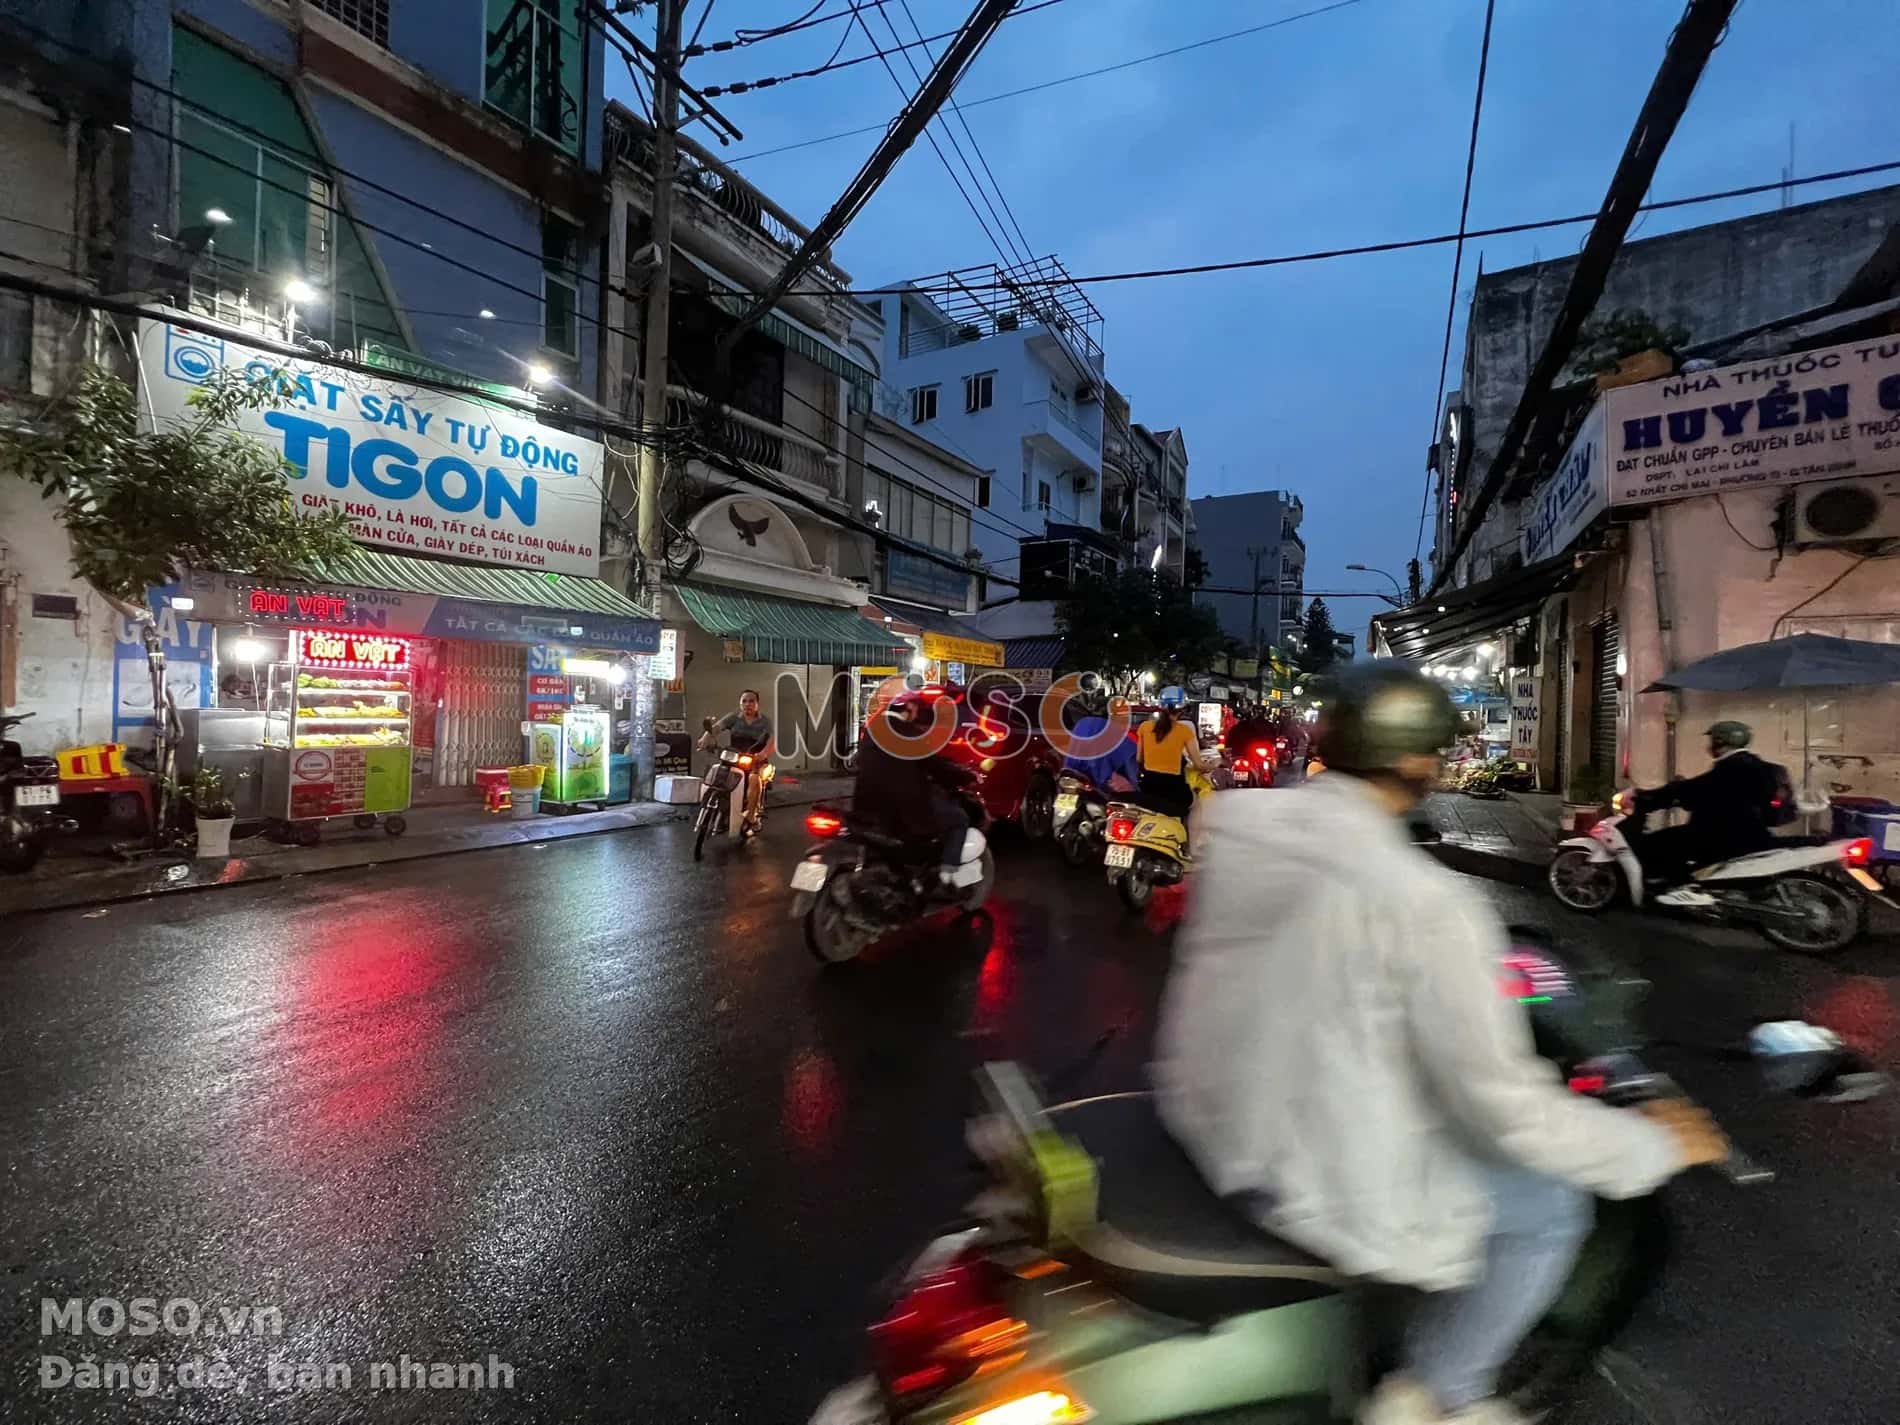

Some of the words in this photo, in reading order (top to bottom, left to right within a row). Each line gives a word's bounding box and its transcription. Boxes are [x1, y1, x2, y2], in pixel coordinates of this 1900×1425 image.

[445, 417, 492, 455] TỰ
[500, 433, 579, 477] ĐỘNG
[1692, 445, 1719, 461] GPP
[264, 410, 538, 527] TIGON
[386, 508, 405, 523] LÀ
[491, 530, 515, 544] CÁC
[515, 549, 545, 566] XÁCH
